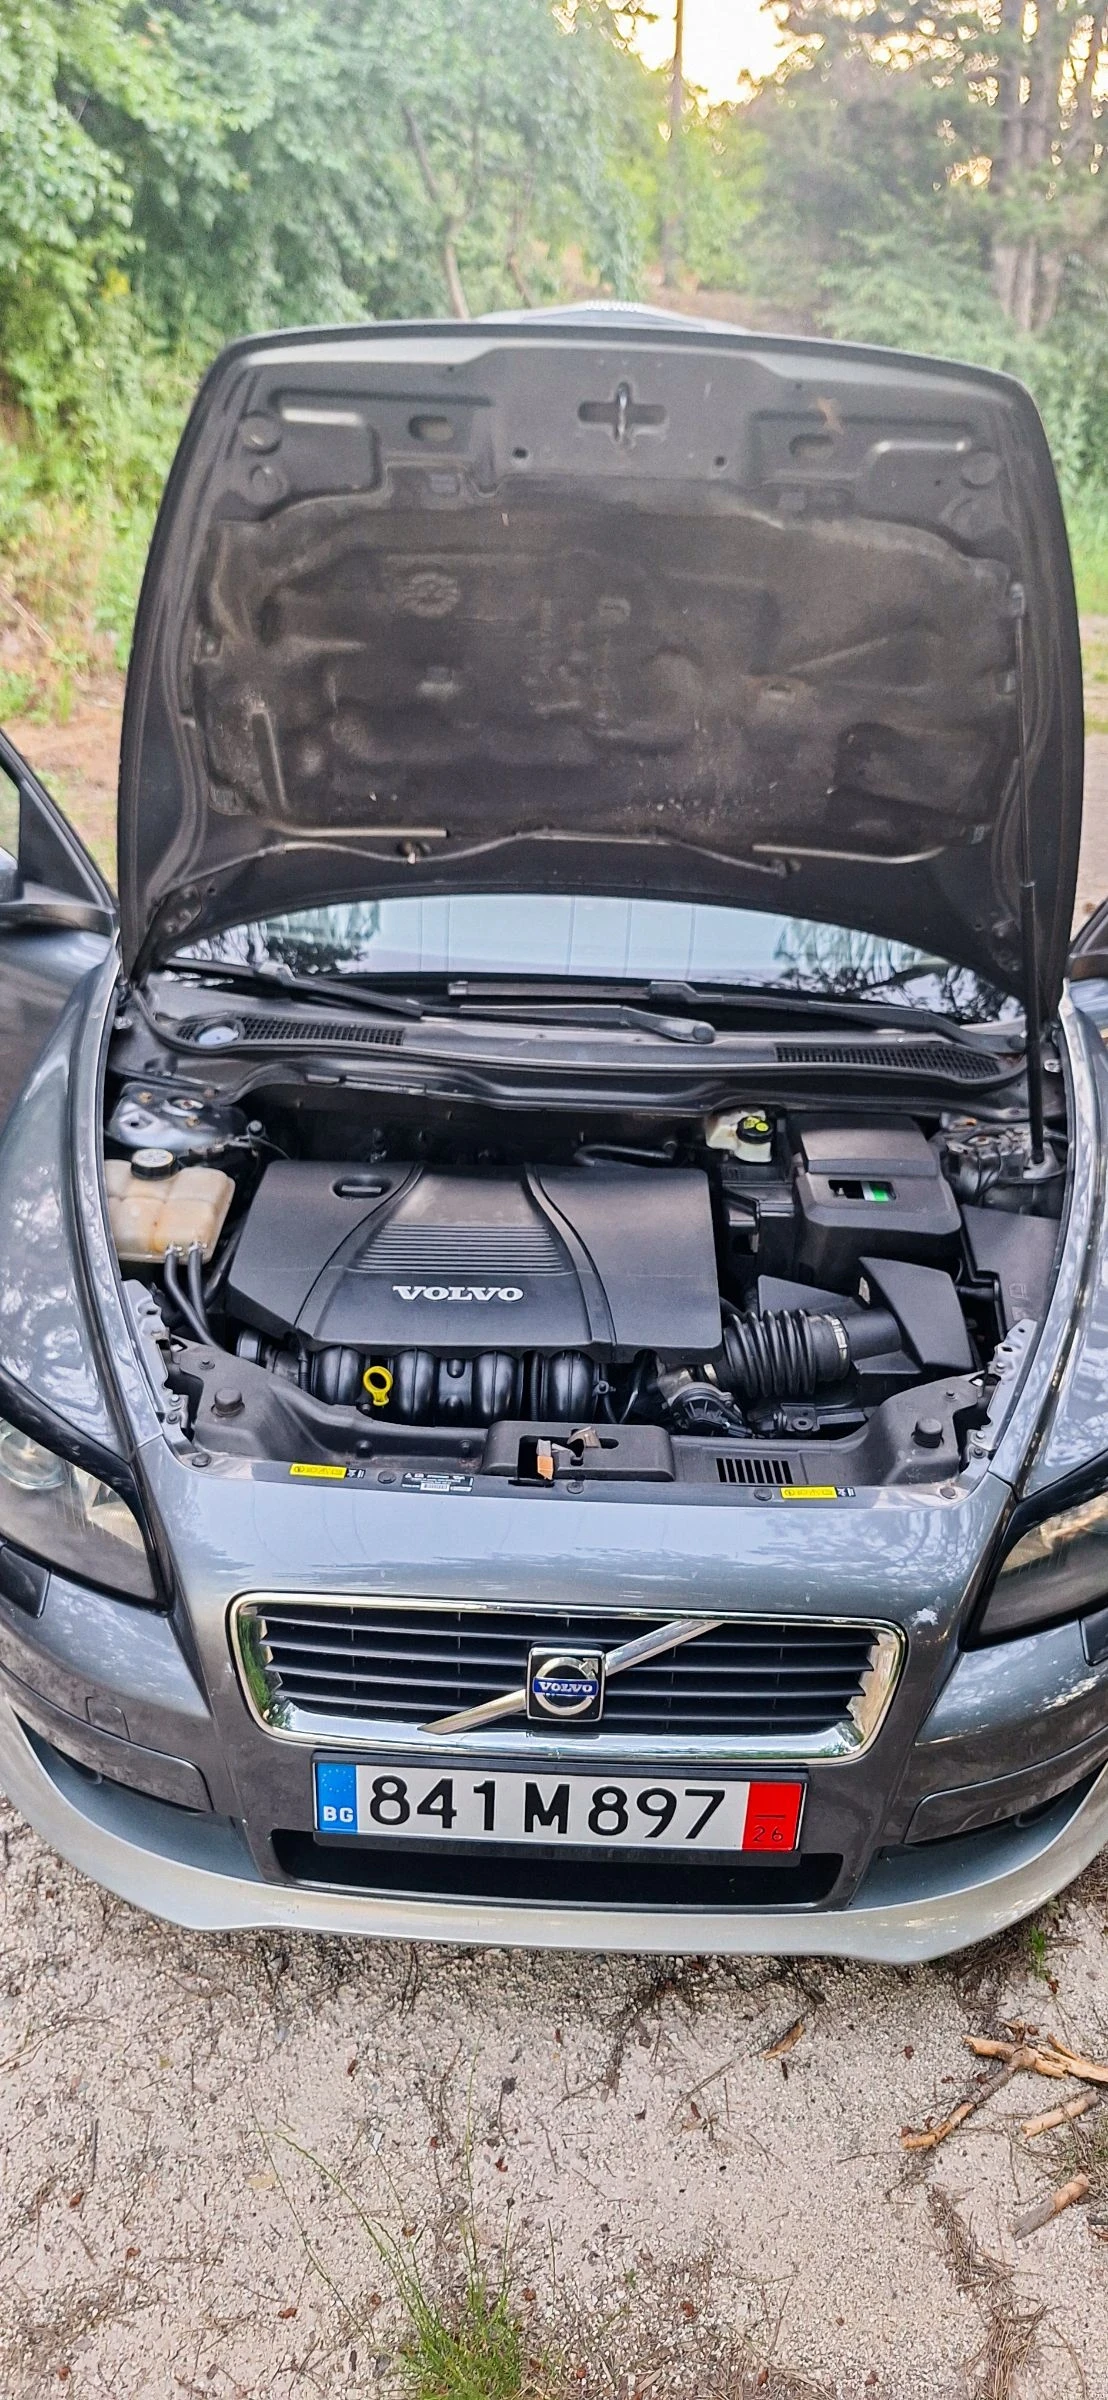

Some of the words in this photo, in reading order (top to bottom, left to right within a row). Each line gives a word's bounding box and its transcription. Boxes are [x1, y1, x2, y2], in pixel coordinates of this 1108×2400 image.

[392, 1285, 524, 1301] VOLVO
[538, 1681, 593, 1693] VOLVO
[323, 1806, 354, 1823] BG
[369, 1774, 496, 1830] 841
[523, 1781, 570, 1834] M
[587, 1785, 726, 1840] 897
[752, 1825, 784, 1842] 26
